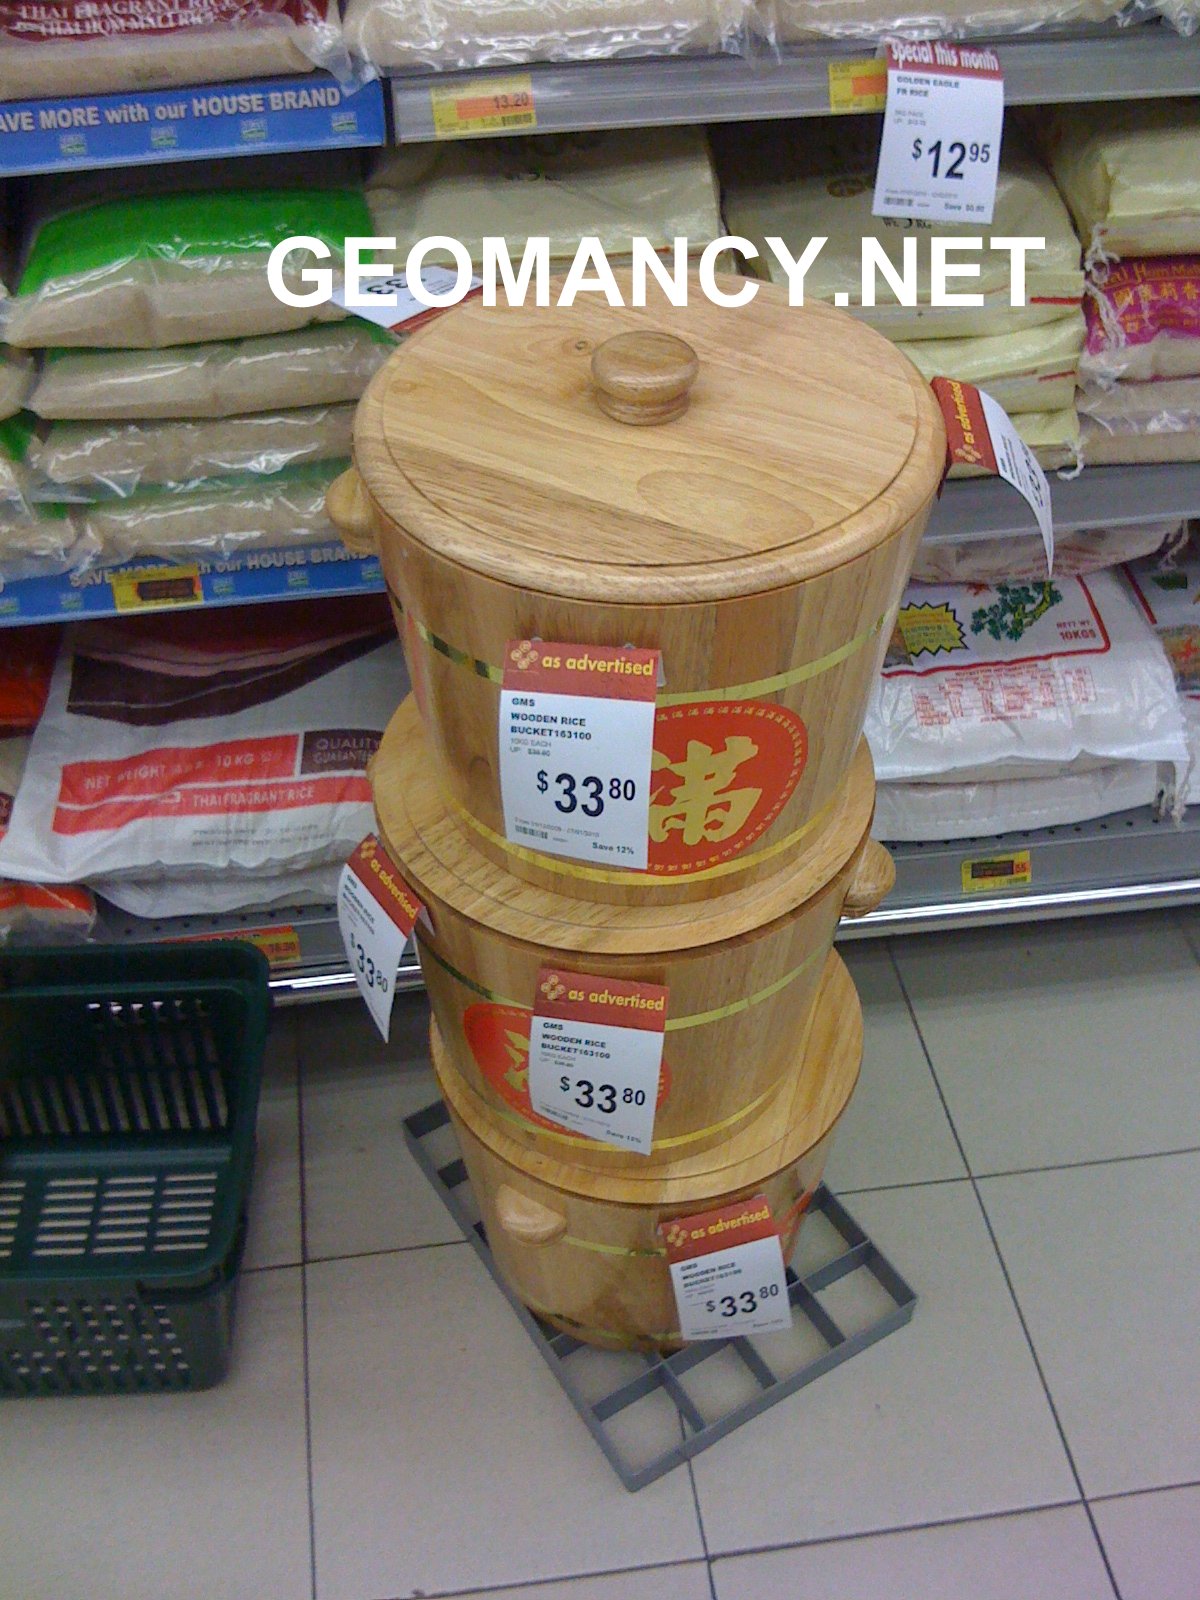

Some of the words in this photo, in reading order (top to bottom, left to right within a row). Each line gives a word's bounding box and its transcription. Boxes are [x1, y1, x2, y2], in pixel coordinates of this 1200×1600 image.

[891, 39, 933, 69] Special
[934, 41, 958, 67] this
[959, 46, 999, 71] month
[897, 75, 931, 87] GOLDEN
[932, 77, 960, 88] EAGLE
[39, 106, 101, 130] MORE
[104, 102, 149, 124] with
[155, 103, 188, 121] our
[193, 93, 266, 118] HOUSE
[268, 87, 341, 112] BRAND
[493, 92, 529, 110] 13.20
[215, 560, 242, 573] our
[247, 550, 307, 570] HOUSE
[541, 655, 561, 669] as
[565, 653, 654, 676] advertised
[511, 697, 536, 708] GMS
[510, 712, 558, 724] WOODEN
[560, 715, 587, 727] RICE
[191, 793, 223, 808] THAI
[287, 785, 314, 800] RICE
[592, 841, 614, 852] Save
[616, 844, 635, 855] 12%
[378, 871, 419, 920] advertised
[567, 989, 585, 1001] as
[588, 989, 665, 1011] advertised
[543, 1022, 564, 1032] GMS
[541, 1033, 583, 1046] WOODEN
[584, 1038, 607, 1049] RICE
[690, 1227, 706, 1240] as
[707, 1205, 770, 1235] advertised
